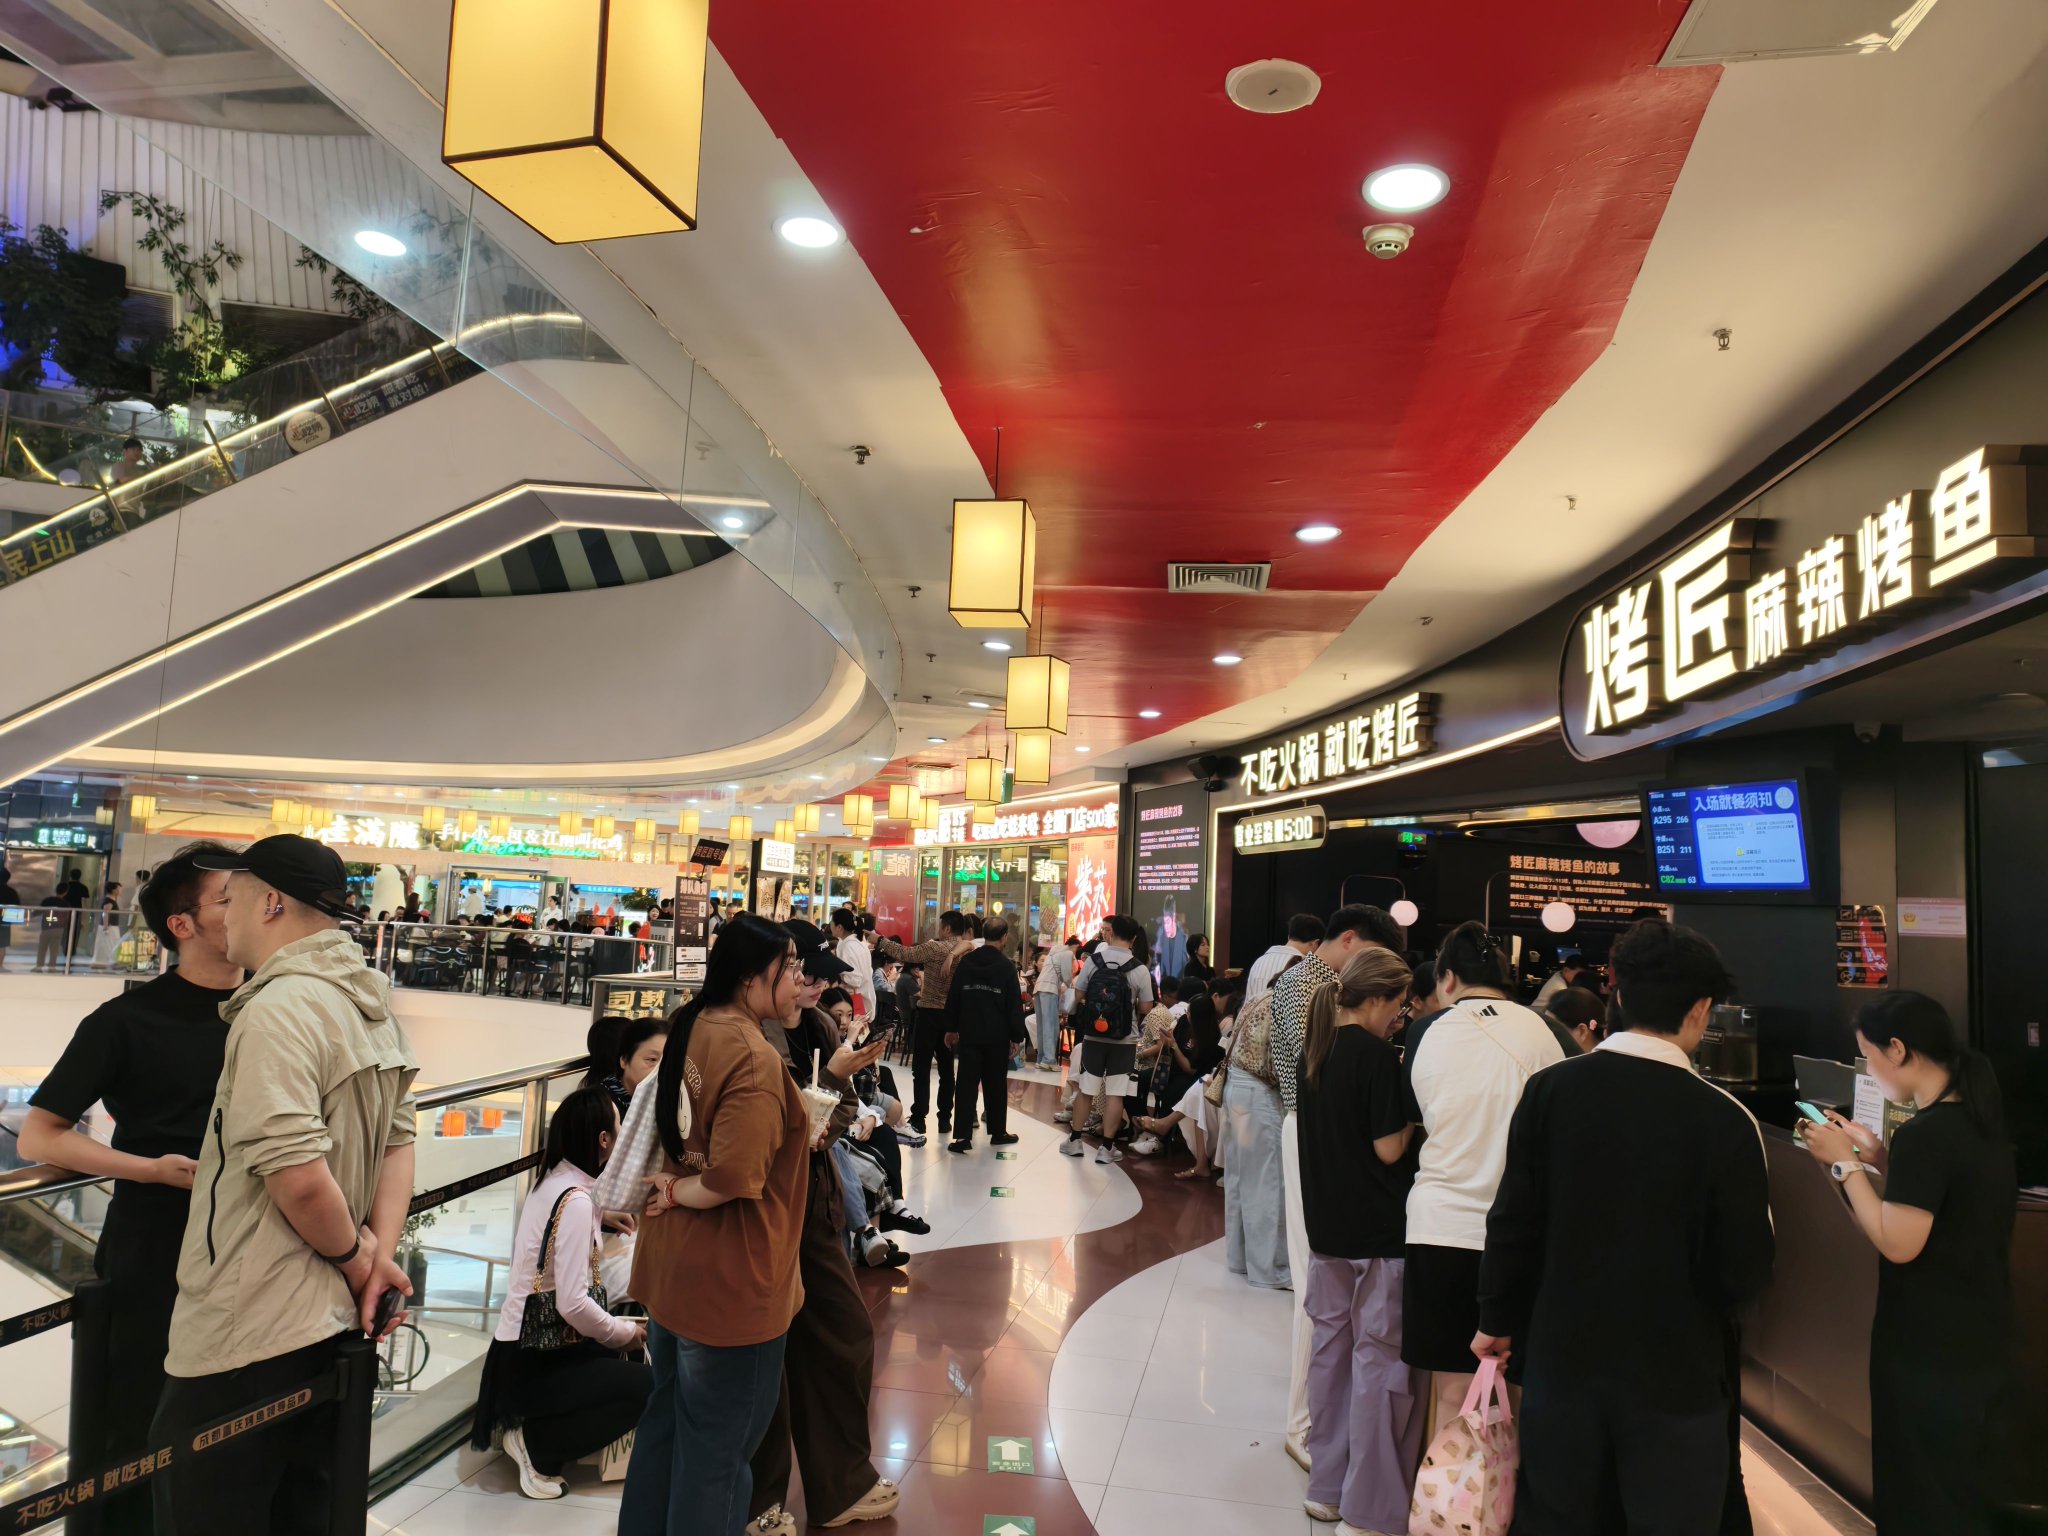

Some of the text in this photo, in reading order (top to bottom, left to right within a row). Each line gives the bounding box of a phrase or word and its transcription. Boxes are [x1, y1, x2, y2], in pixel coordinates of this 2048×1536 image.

[1584, 448, 1998, 735] 烤匠 麻辣烤鱼
[1240, 692, 1419, 796] 不吃火锅 就吃烤匠
[1694, 791, 1773, 812] 入场就餐须知
[1653, 816, 1672, 825] A295
[1656, 845, 1692, 854] B251 211
[1509, 855, 1621, 876] 烤匠麻辣烤鱼的故事
[1660, 875, 1675, 884] C82
[15, 1447, 173, 1525] 不吃火锅 就吃烤匠
